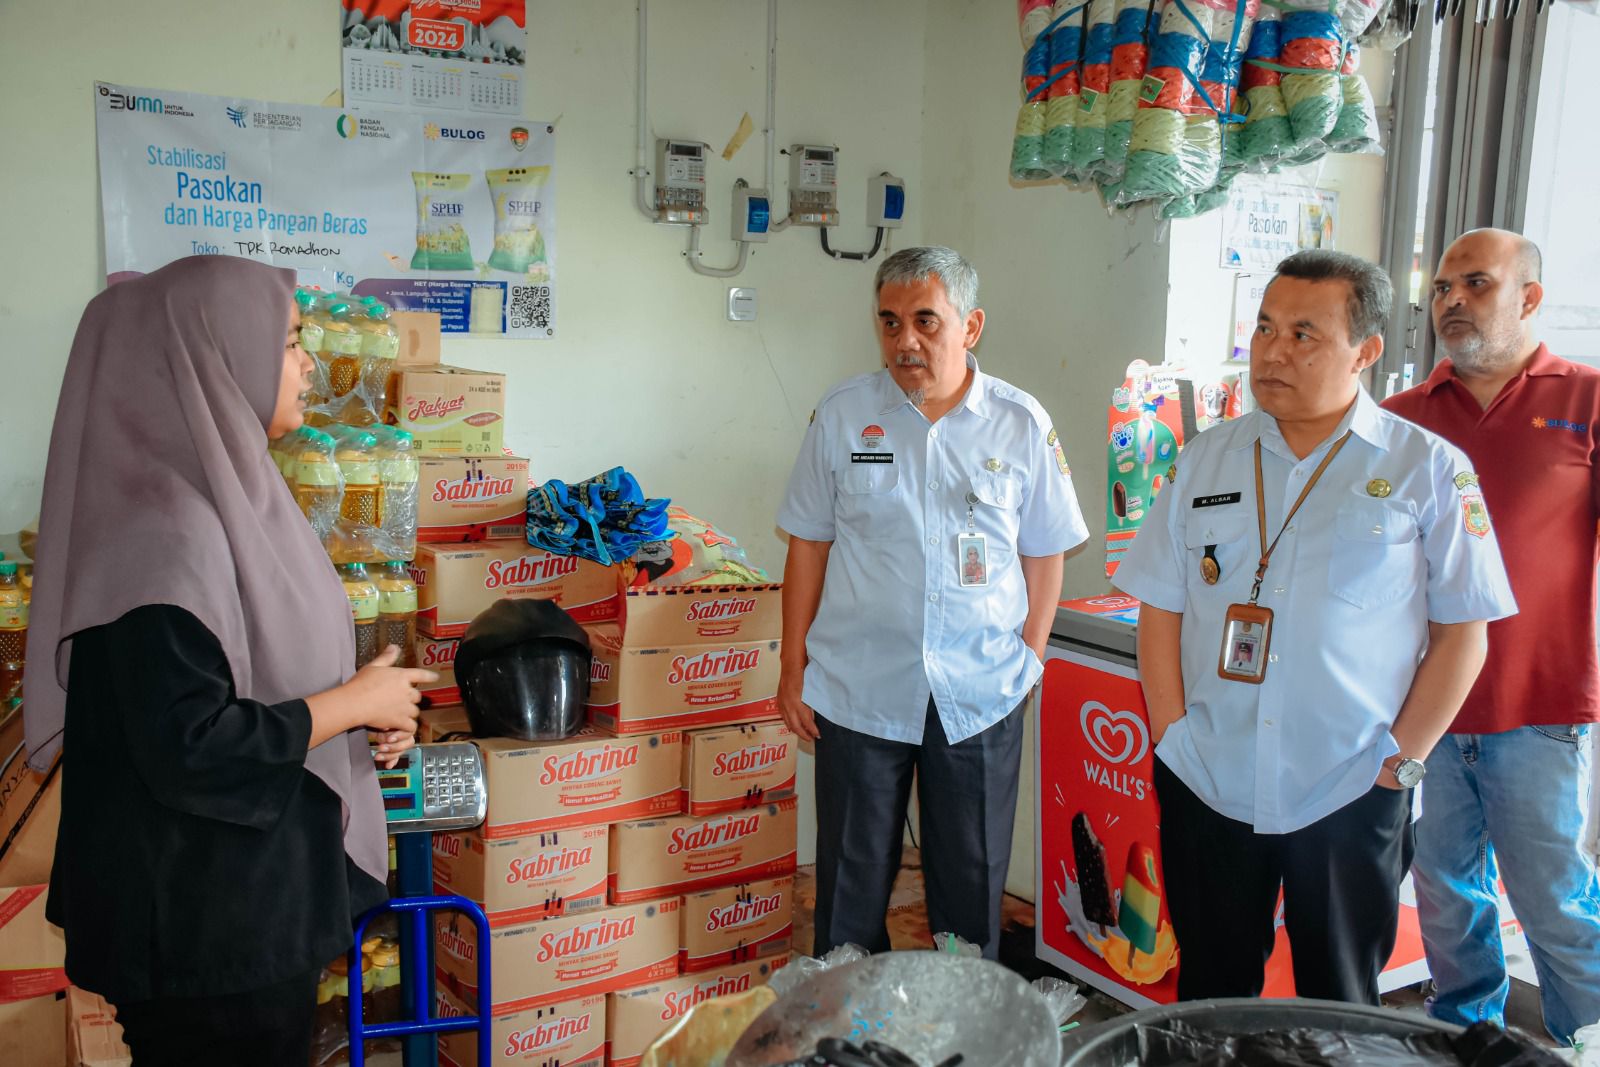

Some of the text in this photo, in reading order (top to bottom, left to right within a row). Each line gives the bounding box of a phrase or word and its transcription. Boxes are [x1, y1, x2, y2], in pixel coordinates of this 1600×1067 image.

[415, 29, 458, 47] 2024
[253, 112, 301, 121] KEMENTERIAN
[360, 131, 391, 139] NASIONAL
[441, 128, 485, 140] BULOG
[147, 145, 226, 170] Stabilisasi
[177, 172, 262, 203] Pasokan
[164, 202, 368, 235] dan Harga Pangan Beras
[1248, 212, 1288, 235] Pasokan
[235, 241, 264, 255] TPK
[336, 271, 354, 288] Kg
[408, 395, 464, 421] Rakyat
[433, 475, 514, 501] Sabrina
[486, 553, 578, 589] Sabrina
[687, 597, 757, 621] Sabrina
[668, 647, 760, 684] Sabrina
[540, 744, 639, 786] Sabrina
[713, 743, 788, 776] Sabrina
[1084, 759, 1145, 801] WALL'S
[668, 815, 760, 855] Sabrina
[507, 847, 593, 884] Sabrina
[707, 893, 781, 931] Sabrina
[437, 921, 474, 961] Sabrina
[536, 915, 636, 963] Sabrina
[562, 971, 580, 979] Hemat
[661, 973, 751, 1020] Sabrina
[505, 1012, 591, 1057] Sabrina
